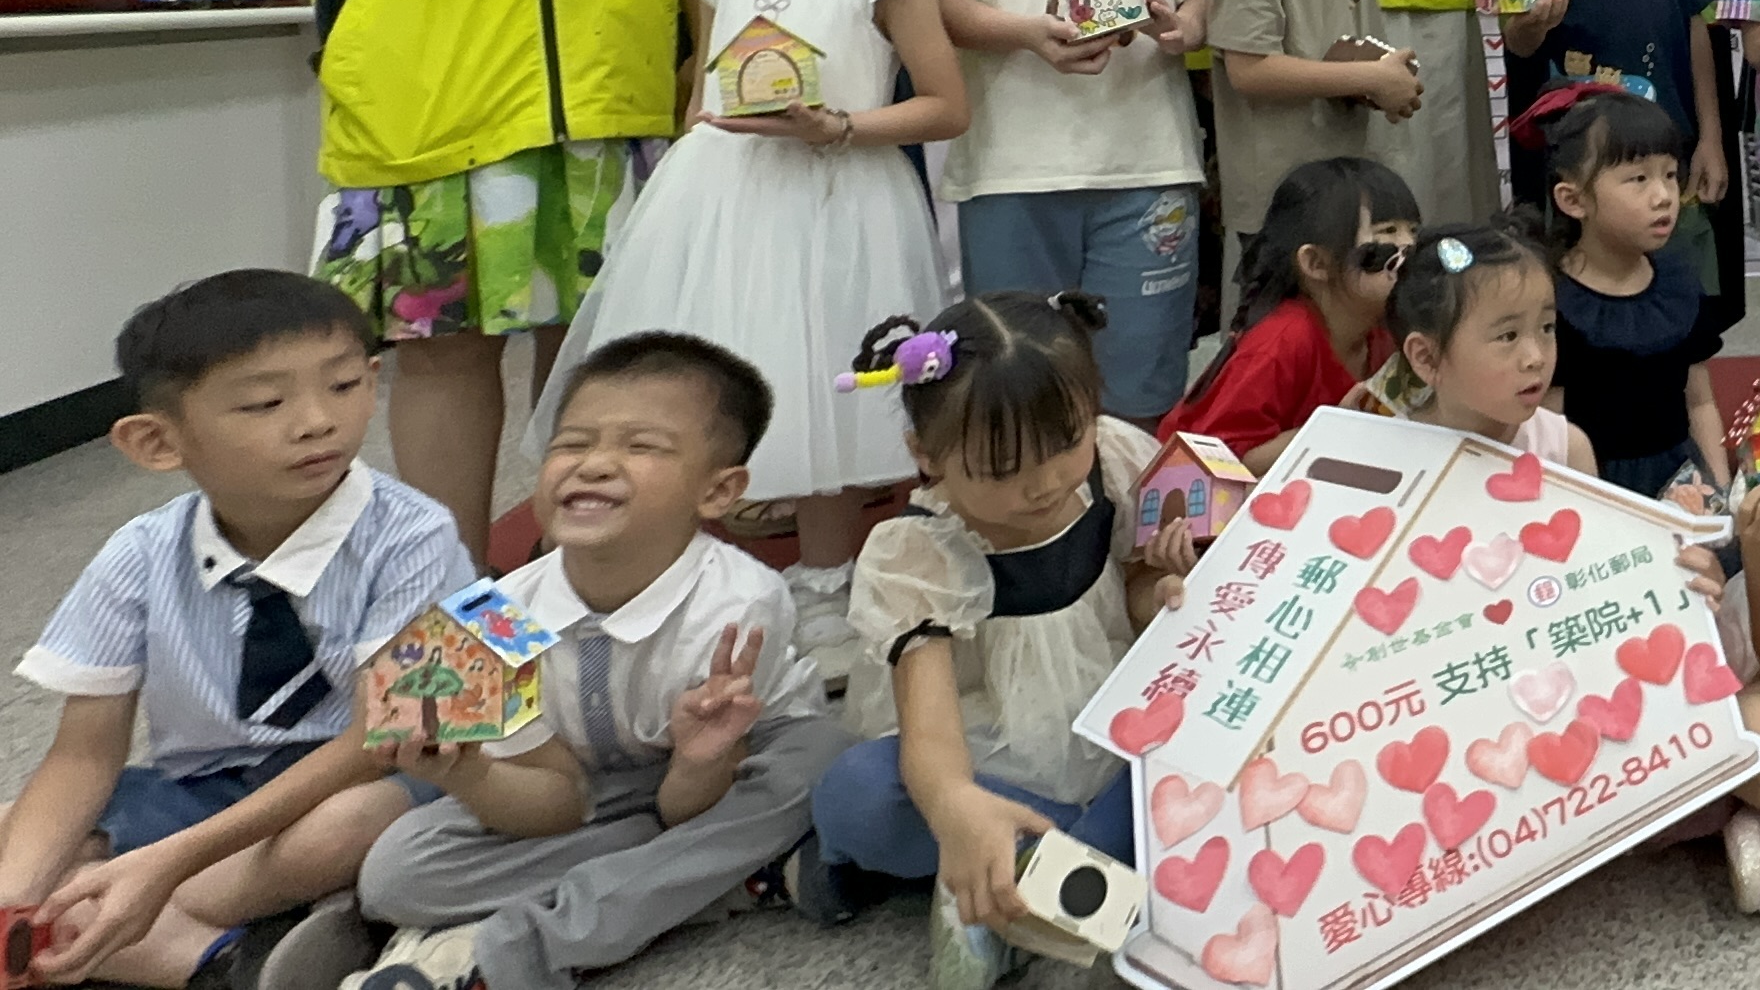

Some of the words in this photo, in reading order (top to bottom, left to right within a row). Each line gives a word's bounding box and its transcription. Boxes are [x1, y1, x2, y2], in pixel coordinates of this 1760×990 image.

[1564, 545, 1654, 592] 彰化郵局
[1143, 537, 1286, 706] 傳愛永續
[1200, 553, 1349, 731] 郵心相連
[1366, 612, 1475, 664] 創世基金會
[1300, 679, 1426, 756] 600元
